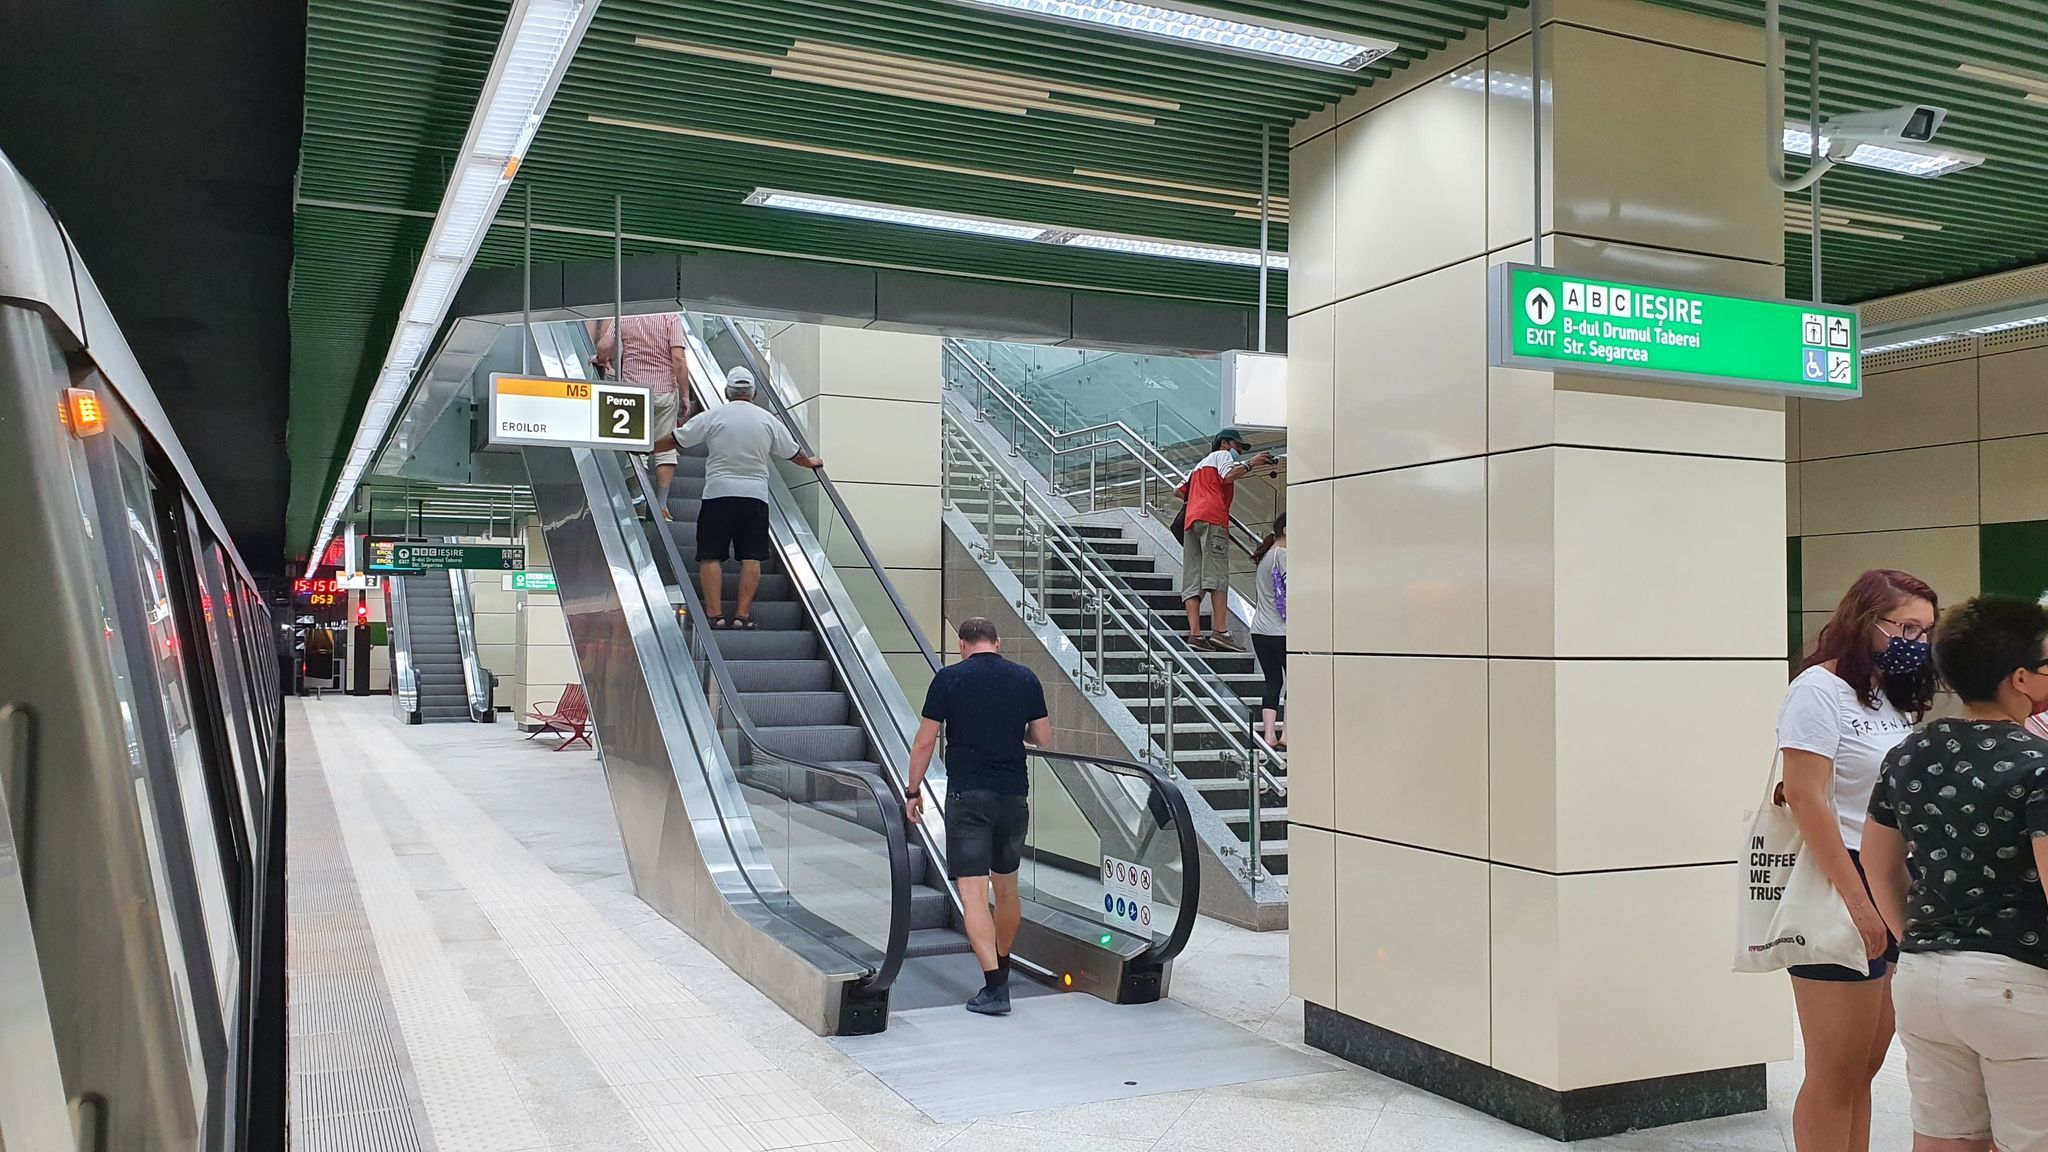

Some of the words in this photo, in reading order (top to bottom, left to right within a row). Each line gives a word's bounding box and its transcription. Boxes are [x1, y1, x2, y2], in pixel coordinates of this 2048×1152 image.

[1568, 288, 1579, 306] A
[1592, 292, 1602, 308] B
[1615, 294, 1626, 311] C
[1634, 293, 1703, 326] IEȘIRE
[1526, 328, 1556, 346] EXIT
[1563, 317, 1600, 337] B-dul
[1603, 321, 1652, 343] Drumul
[1653, 327, 1700, 348] Taberei
[1563, 337, 1586, 355] Str.
[1589, 340, 1648, 362] Segarcea
[566, 384, 588, 397] M5
[606, 395, 636, 407] Peron
[502, 421, 547, 433] EROILOR
[612, 409, 630, 434] 2
[294, 581, 326, 592] 15:15
[368, 578, 374, 586] 2
[1751, 836, 1764, 850] IN
[1750, 852, 1796, 867] COFFEE
[1750, 870, 1770, 883] WE
